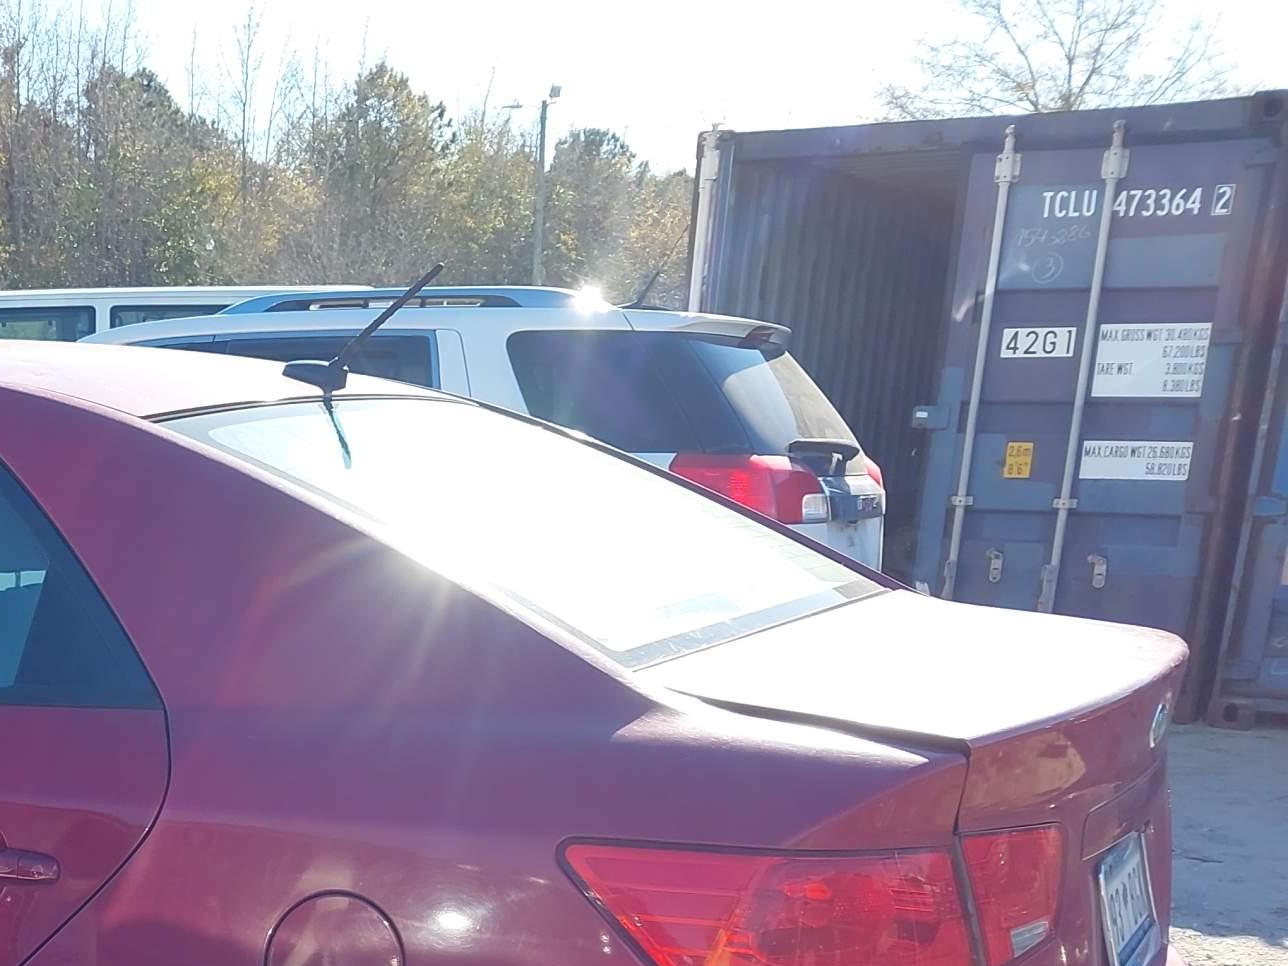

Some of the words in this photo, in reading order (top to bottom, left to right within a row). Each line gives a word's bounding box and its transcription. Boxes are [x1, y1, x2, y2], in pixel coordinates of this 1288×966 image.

[1041, 190, 1098, 218] TCLU
[1112, 187, 1203, 217] 473364
[1215, 186, 1232, 213] 2
[1005, 330, 1073, 355] 42G1
[1116, 362, 1133, 375] WGT
